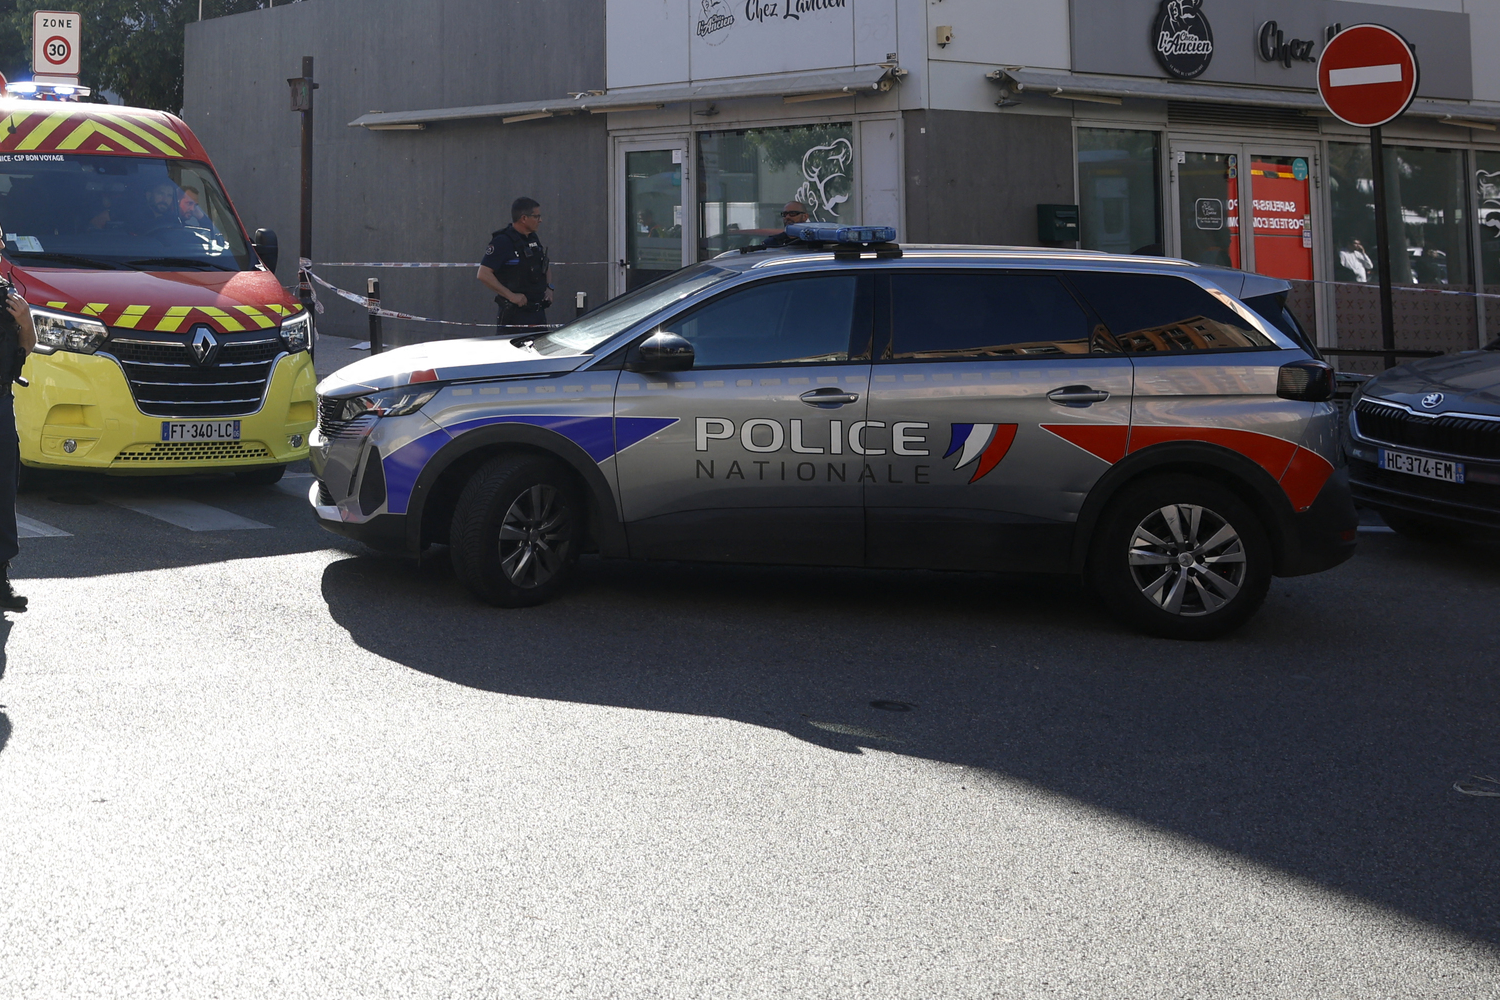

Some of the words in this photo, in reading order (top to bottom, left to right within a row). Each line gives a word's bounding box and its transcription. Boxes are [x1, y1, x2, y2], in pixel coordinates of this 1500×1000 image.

[42, 18, 72, 28] ZONE
[48, 43, 66, 56] 30
[1258, 20, 1316, 69] Chez
[170, 423, 232, 439] FT-340-LC
[695, 416, 930, 456] POLICE
[695, 459, 931, 485] NATIONALE
[1386, 452, 1453, 480] HC-374-EM
[1455, 473, 1464, 483] 13
